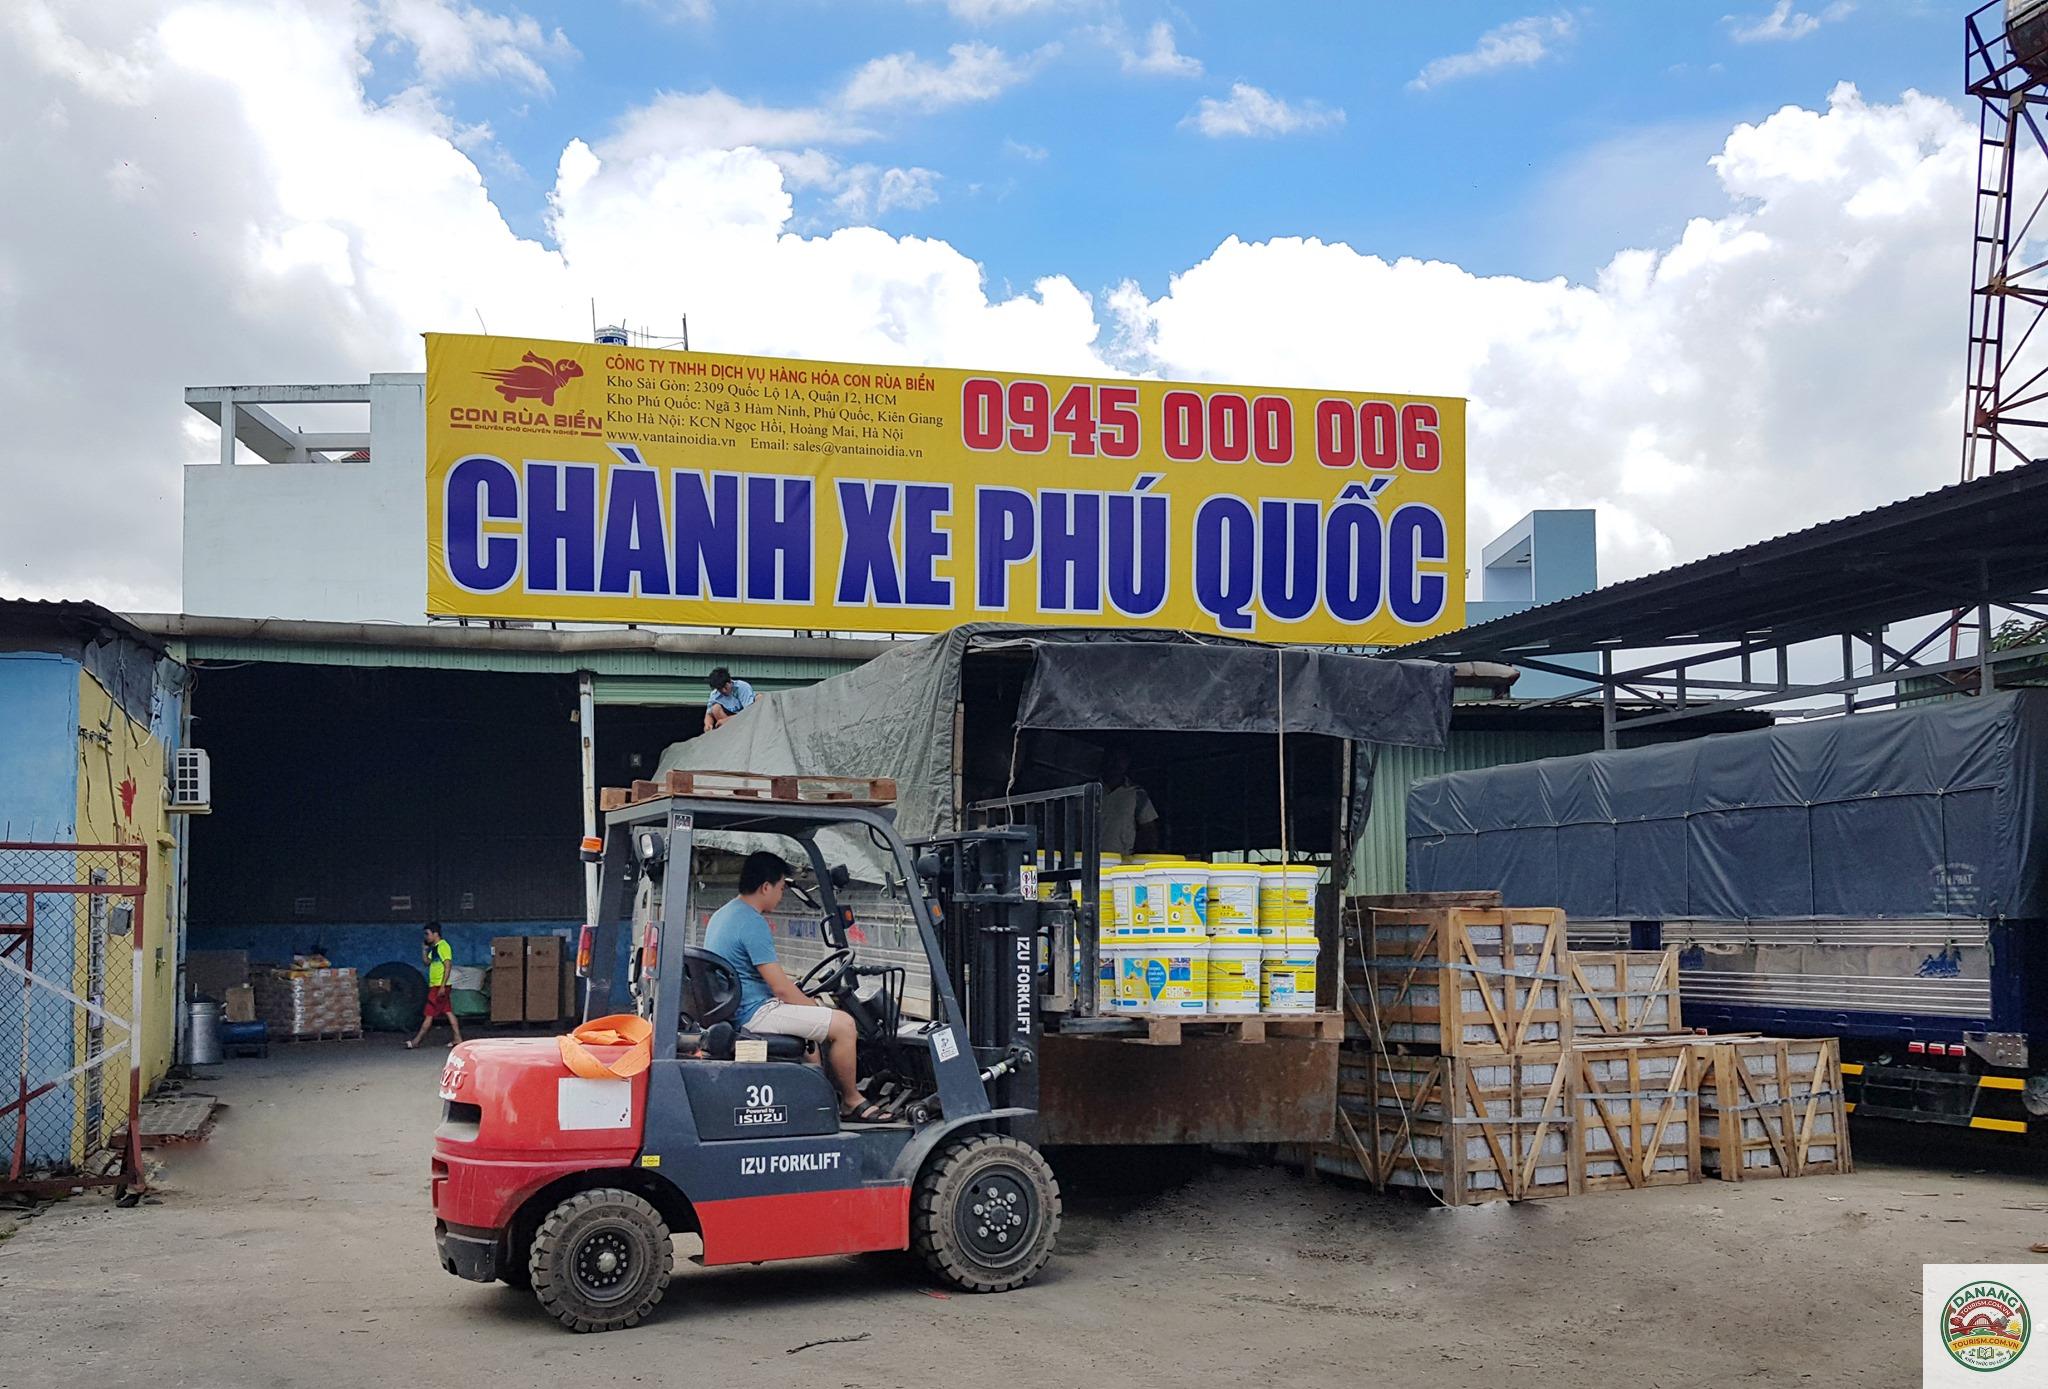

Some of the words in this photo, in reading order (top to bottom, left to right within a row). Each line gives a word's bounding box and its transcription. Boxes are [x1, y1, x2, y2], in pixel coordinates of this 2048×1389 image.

[606, 353, 645, 371] CÔNG
[649, 360, 665, 373] TY
[669, 361, 706, 376] TNHH
[712, 364, 743, 380] DỊCH
[747, 367, 765, 384] VỤ
[770, 366, 807, 383] HÀNG
[812, 369, 840, 386] HÓA
[844, 374, 871, 388] CON
[875, 373, 902, 390] RÙA
[906, 373, 935, 391] BIỂN
[607, 376, 633, 388] Kho
[637, 378, 656, 389] Sài
[660, 379, 690, 392] Gòn:
[694, 381, 724, 393] 2309
[728, 383, 759, 397] Quốc
[764, 387, 780, 400] Lộ
[785, 388, 805, 401] 1A,
[809, 389, 839, 404] Quận
[845, 392, 861, 404] 12,
[865, 393, 897, 405] HCM
[450, 407, 497, 422] CON
[503, 408, 550, 427] RÙA
[554, 409, 602, 429] BIỂN
[607, 393, 633, 405] Kho
[637, 395, 660, 407] Phú
[664, 395, 701, 410] Quốc:
[705, 399, 730, 414] Ngã
[734, 402, 740, 413] 3
[745, 403, 773, 415] Hàm
[777, 405, 810, 418] Ninh,
[814, 407, 836, 419] Phú
[840, 407, 874, 422] Quốc,
[878, 411, 905, 423] Kiên
[909, 412, 943, 427] Giang
[607, 411, 633, 423] Kho
[637, 412, 654, 424] Hà
[659, 414, 684, 428] Nội:
[690, 416, 720, 428] KCN
[725, 418, 756, 433] Ngọc
[790, 423, 828, 438] Hoàng
[832, 426, 858, 438] Mai,
[863, 427, 878, 438] Hà
[883, 428, 903, 441] Nội
[961, 377, 1141, 459] 0945
[1162, 389, 1294, 467] 000
[1315, 397, 1442, 473] 006
[606, 431, 736, 447] www.vantainoidia.vn
[751, 438, 789, 450] Email:
[793, 440, 923, 457] sales@vantainoidia.vn
[443, 442, 816, 607] CHÀNH
[833, 477, 955, 610] XE
[974, 472, 1171, 618] PHÚ
[1192, 474, 1448, 634] QUỐC
[1017, 937, 1030, 961] IZU
[1017, 964, 1030, 1035] FORKLIFT
[746, 1085, 774, 1107] 30
[740, 1113, 782, 1124] ISUZU
[741, 1157, 766, 1175] IZU
[770, 1152, 840, 1173] FORKLIFT
